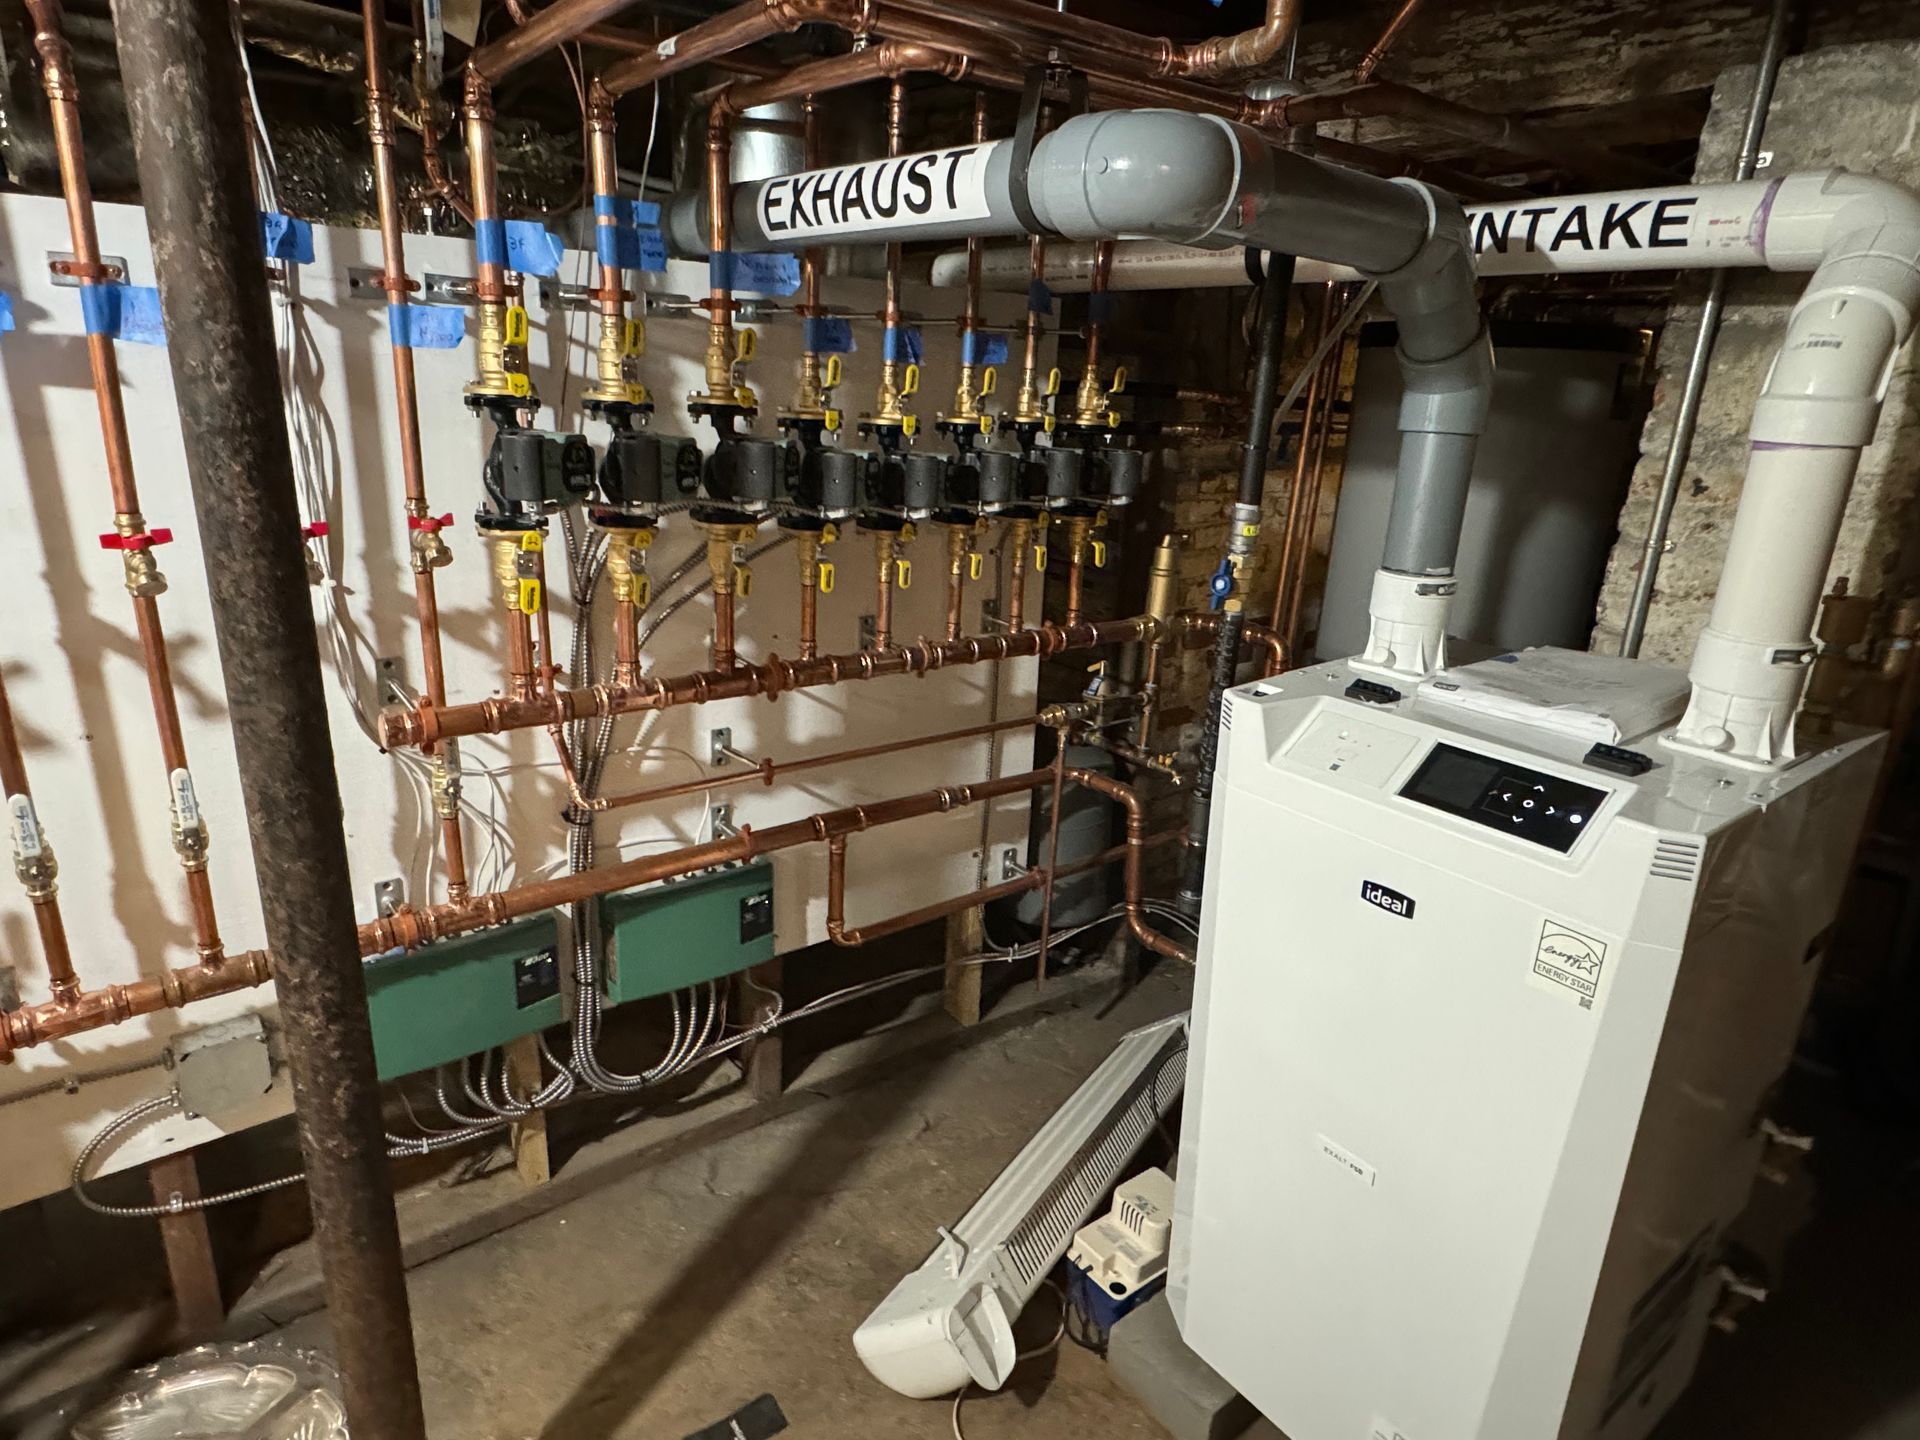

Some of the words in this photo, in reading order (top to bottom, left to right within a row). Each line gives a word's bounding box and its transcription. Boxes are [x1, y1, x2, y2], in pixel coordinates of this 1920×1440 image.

[764, 148, 978, 232] EXHAUST
[1365, 884, 1408, 915] ideal
[1541, 945, 1583, 968] energy
[1537, 963, 1570, 982] ENERGY
[1570, 978, 1593, 993] STAR
